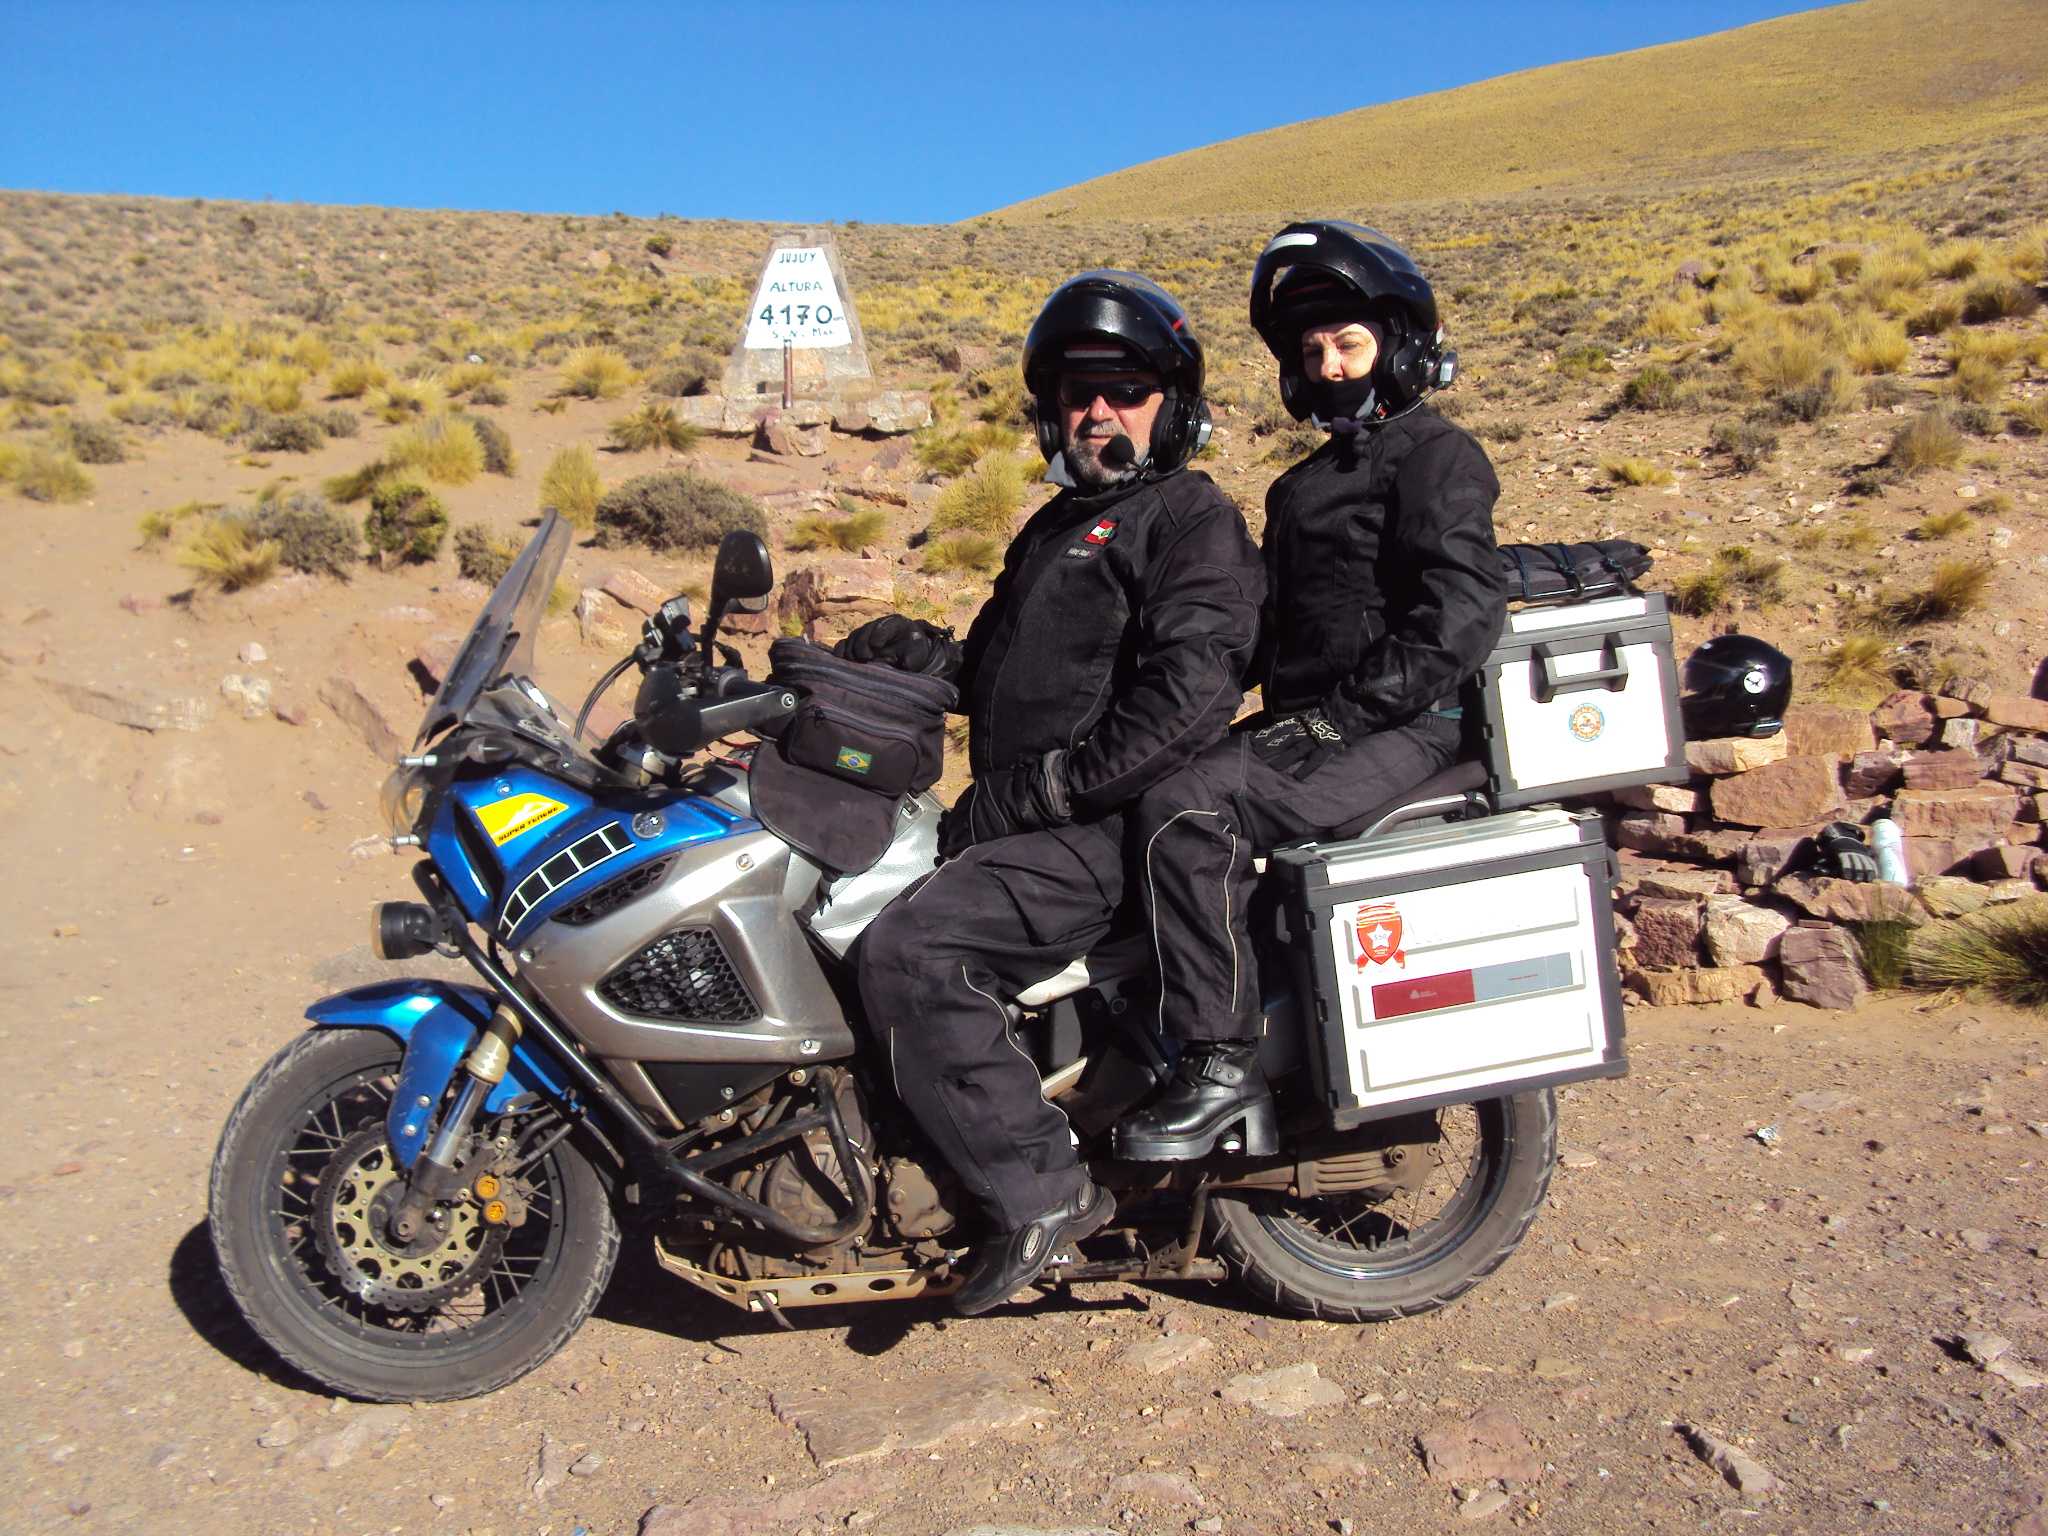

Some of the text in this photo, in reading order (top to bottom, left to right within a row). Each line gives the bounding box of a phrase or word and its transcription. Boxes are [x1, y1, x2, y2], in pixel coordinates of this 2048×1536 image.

[779, 252, 817, 264] JUJUY
[769, 281, 823, 293] ALTURA
[498, 823, 526, 841] SUPER
